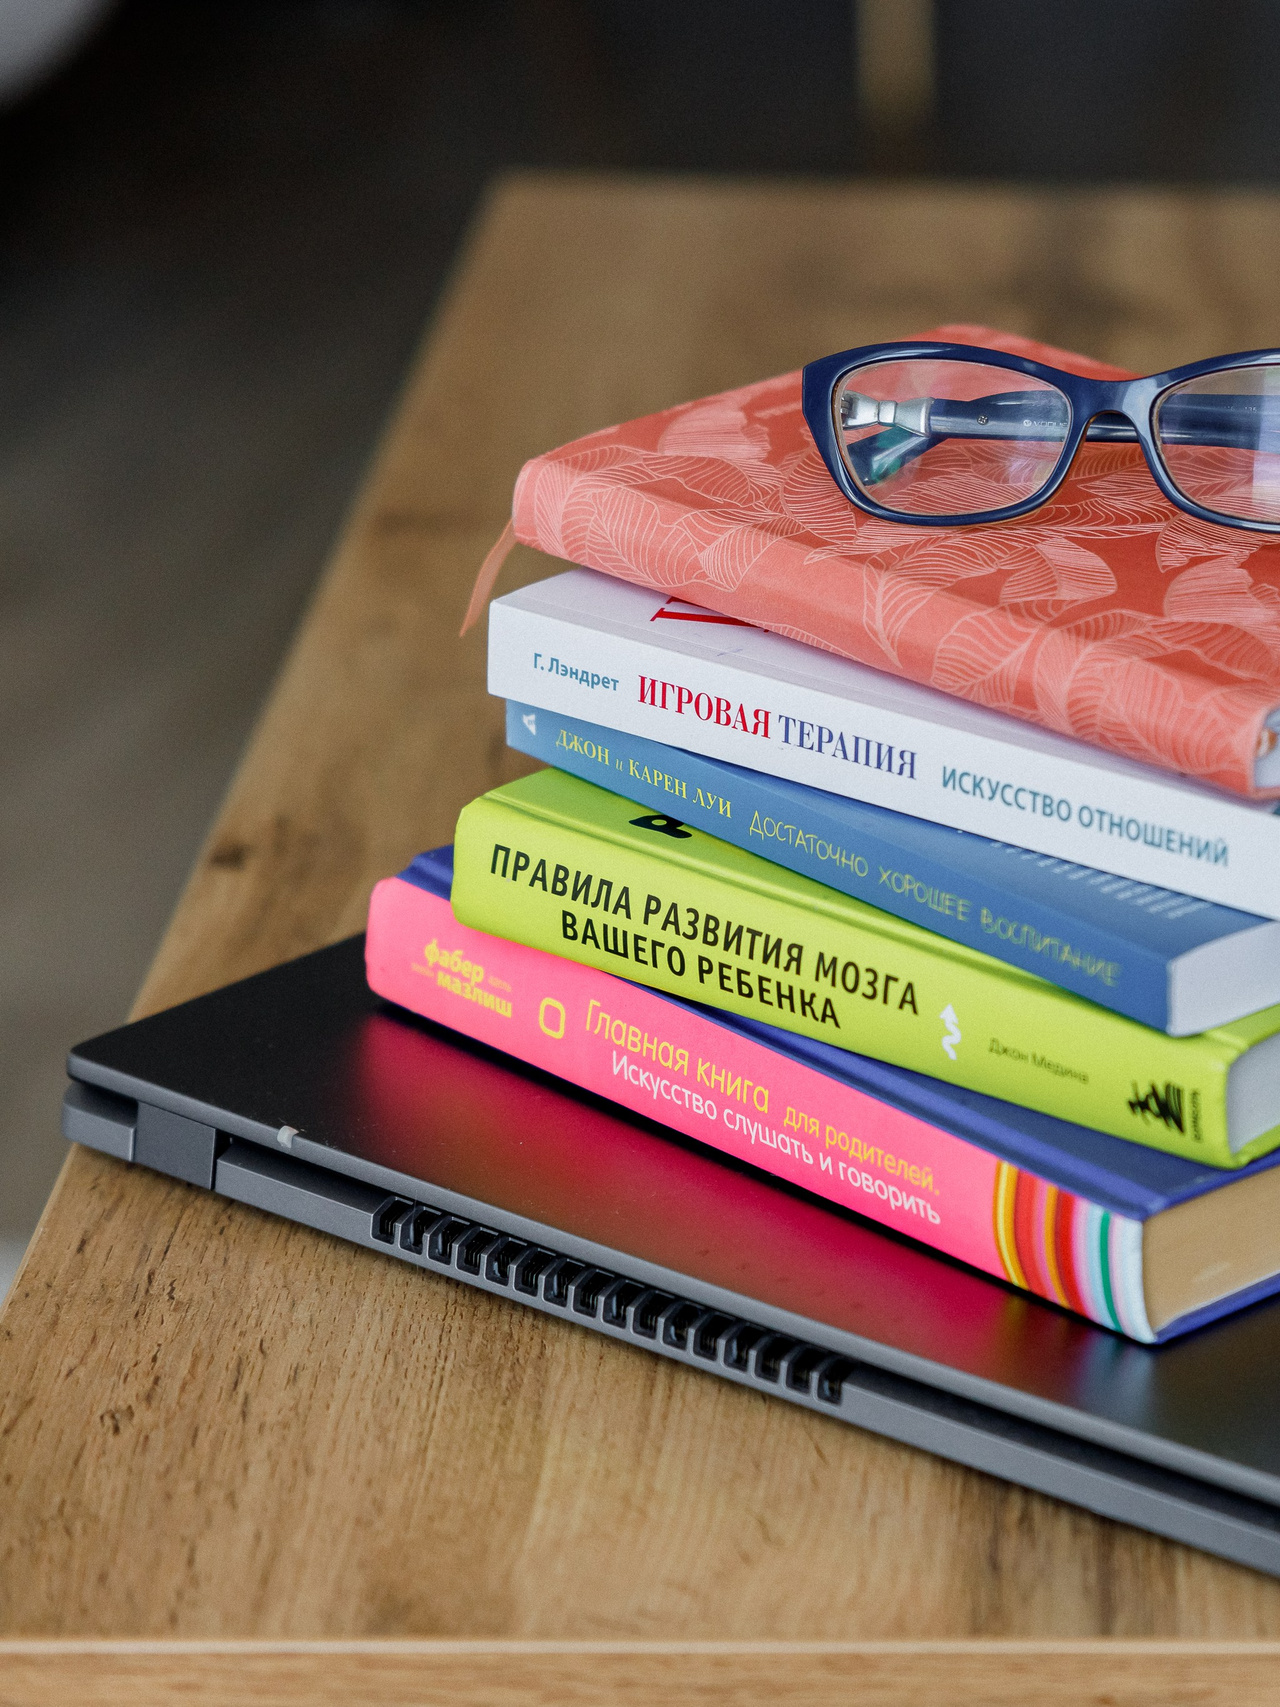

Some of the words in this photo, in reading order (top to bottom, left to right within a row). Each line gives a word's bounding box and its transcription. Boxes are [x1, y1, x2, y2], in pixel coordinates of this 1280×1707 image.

[533, 652, 545, 671] Г.
[548, 657, 619, 691] Лэндрет
[637, 674, 772, 739] ИГРОВАЯ
[778, 714, 918, 780] ТЕРАПИЯ
[942, 765, 1071, 822] ИСКУССТВО
[1078, 805, 1230, 867] ОТНОШЕНИЙ
[490, 843, 632, 920] ПРАВИЛА
[643, 894, 803, 976] РАЗВИТИЯ
[815, 951, 919, 1015] МОЗГА
[556, 729, 610, 766] ДЖОН
[628, 759, 688, 799] КАРЕН
[693, 787, 732, 818] ЛУИ
[749, 810, 869, 877] ДОСТАТОЧНО
[878, 865, 972, 922] ХОРОШЕЕ
[981, 907, 1122, 987] ВОСПИТАНИЕ
[424, 938, 484, 986] фабер
[437, 970, 512, 1018] мазлиш
[561, 910, 686, 977] ВАШЕГО
[698, 954, 841, 1029] РЕБЕНКА
[585, 999, 690, 1076] Главная
[697, 1057, 770, 1114] книга
[784, 1106, 819, 1138] для
[826, 1126, 940, 1195] родителей.
[989, 1037, 1029, 1063] Джон
[612, 1050, 718, 1121] Искусство
[723, 1109, 814, 1165] слушать
[819, 1153, 833, 1176] и
[839, 1162, 941, 1225] говорить
